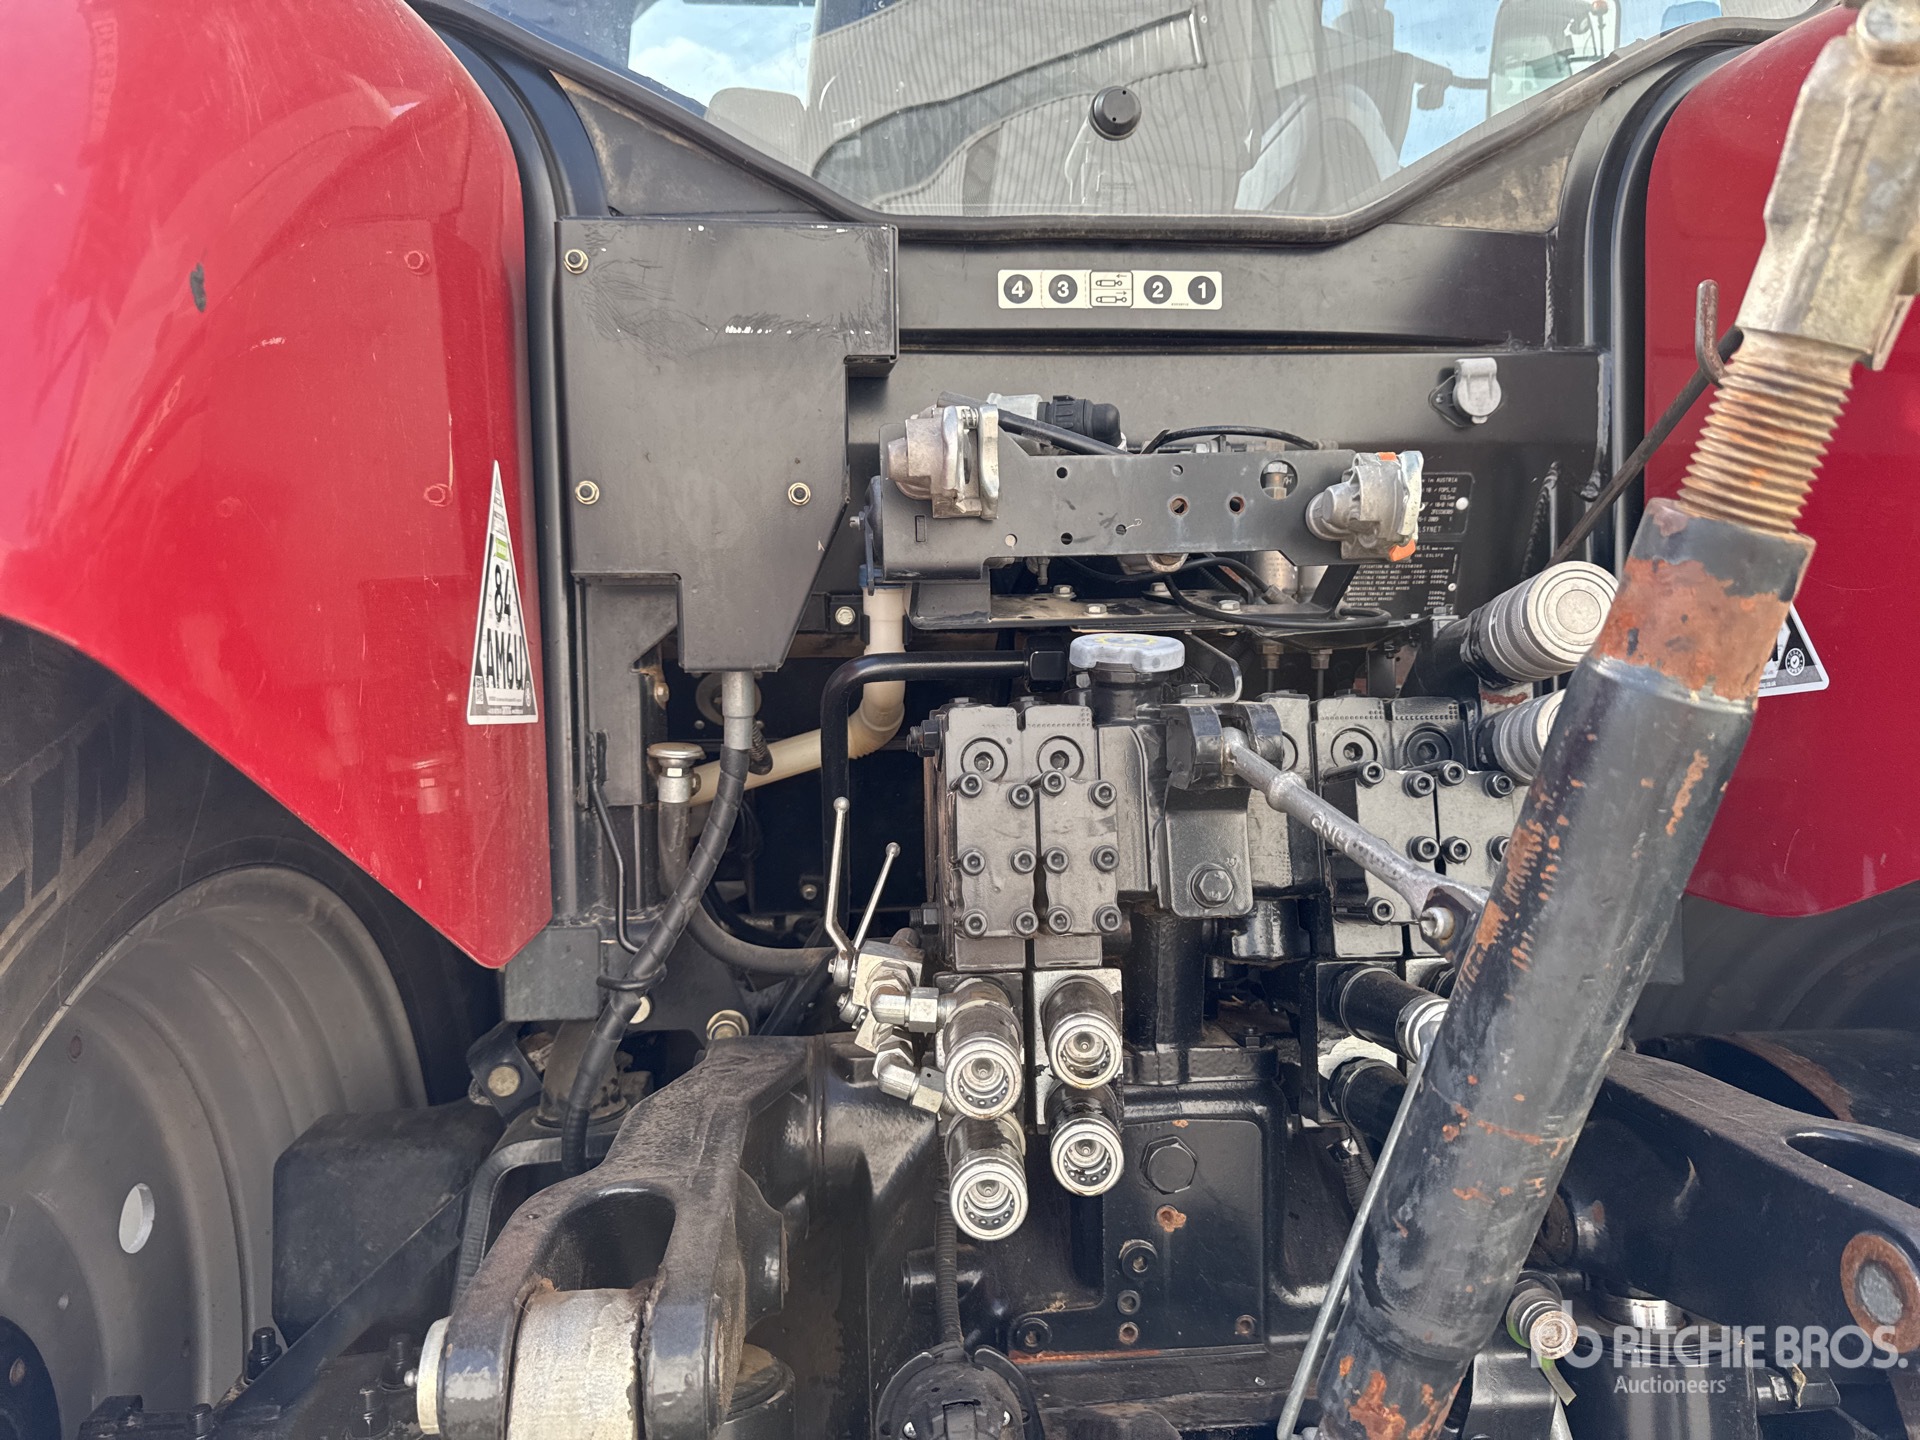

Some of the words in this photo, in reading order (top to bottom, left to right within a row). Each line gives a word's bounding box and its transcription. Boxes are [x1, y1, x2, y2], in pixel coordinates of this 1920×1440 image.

[1011, 280, 1025, 298] 4
[1056, 280, 1070, 298] 3
[1152, 281, 1164, 298] 2
[1198, 282, 1207, 299] 1
[494, 564, 512, 626] 84
